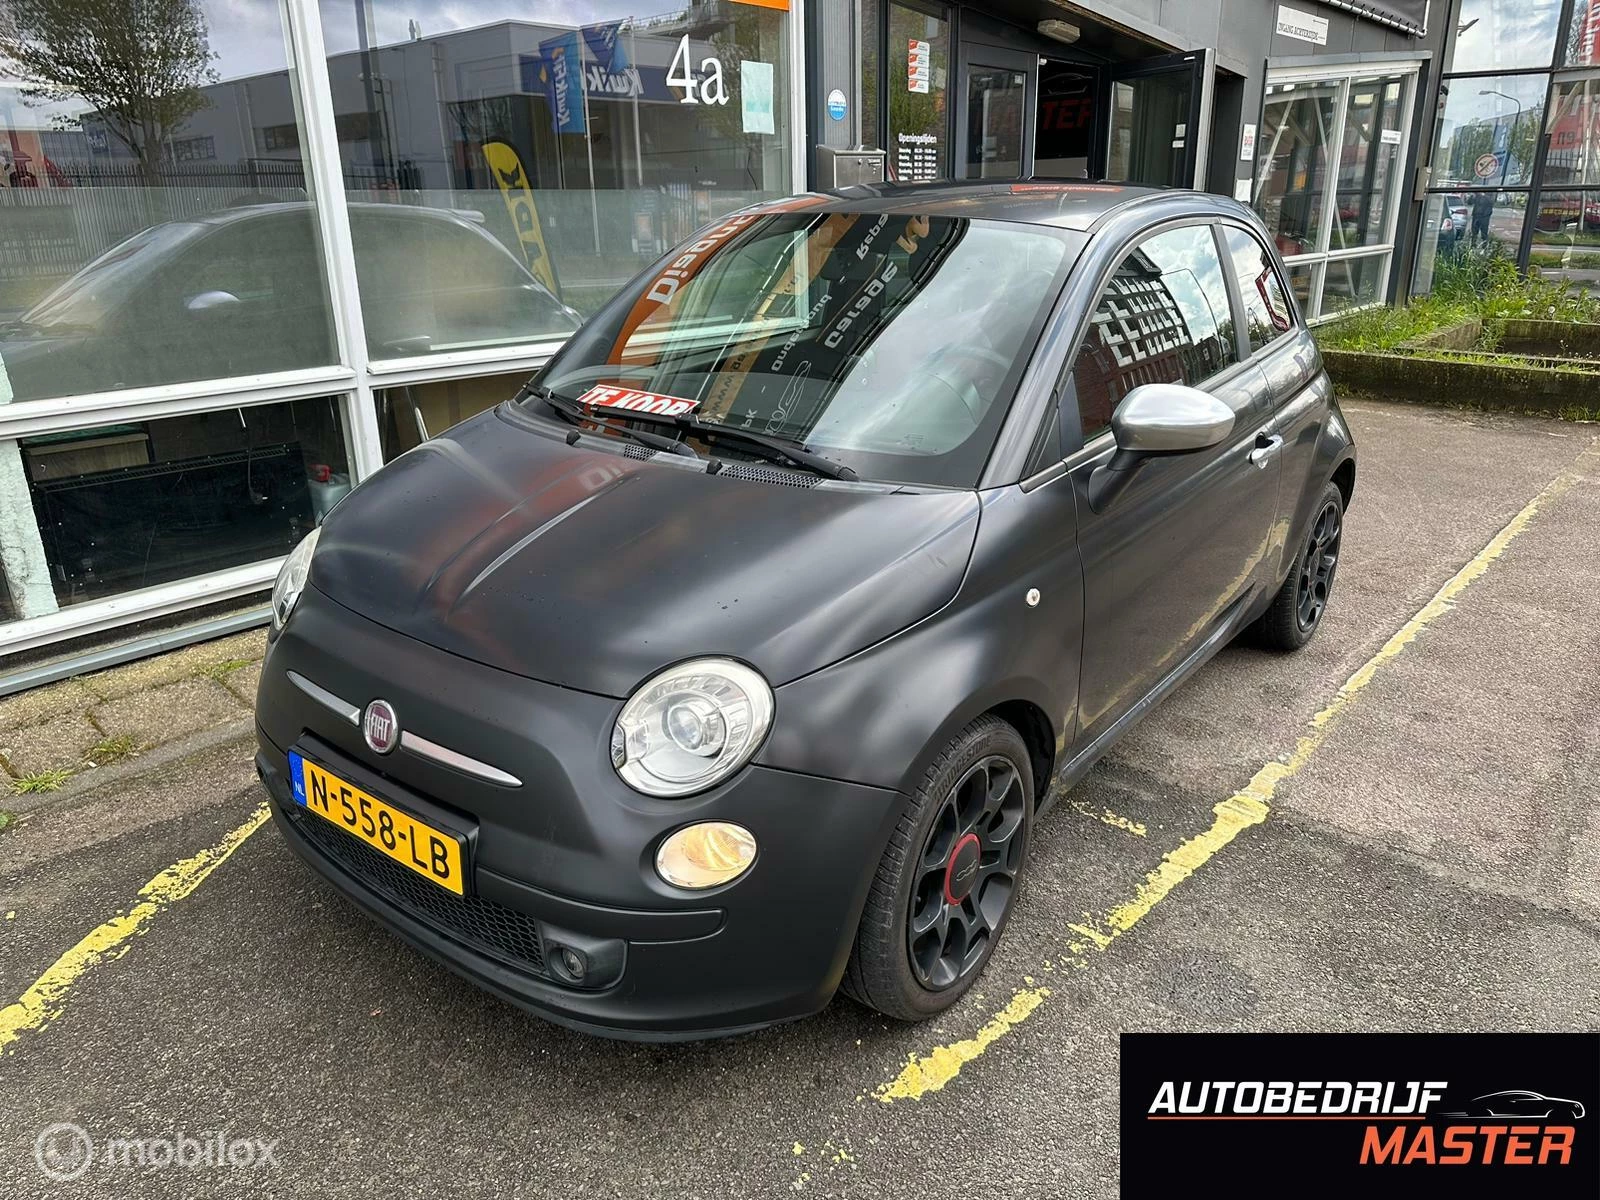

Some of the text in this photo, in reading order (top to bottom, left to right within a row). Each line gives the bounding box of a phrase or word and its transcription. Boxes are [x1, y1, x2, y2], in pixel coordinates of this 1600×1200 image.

[666, 33, 729, 105] 4a
[581, 387, 691, 417] TE KOOP
[371, 712, 391, 742] FIAT
[294, 780, 305, 797] NL
[310, 769, 450, 880] N-558-LB
